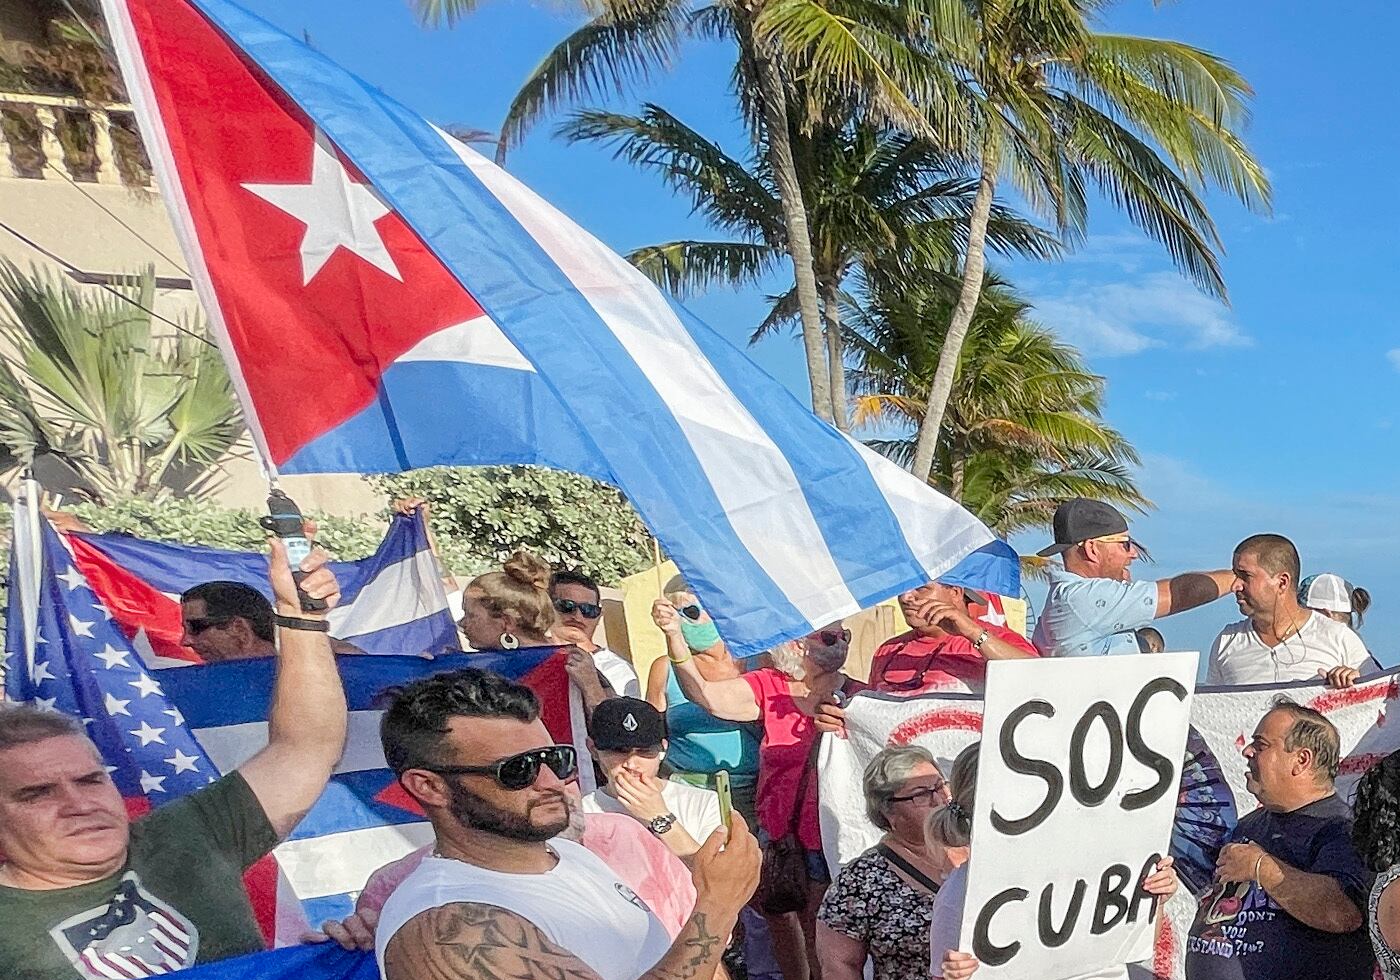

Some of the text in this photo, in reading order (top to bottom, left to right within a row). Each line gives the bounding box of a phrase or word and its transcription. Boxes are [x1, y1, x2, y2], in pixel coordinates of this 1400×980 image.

[990, 677, 1188, 836] SOS
[972, 852, 1162, 967] CUBA
[1221, 926, 1247, 939] YOU
